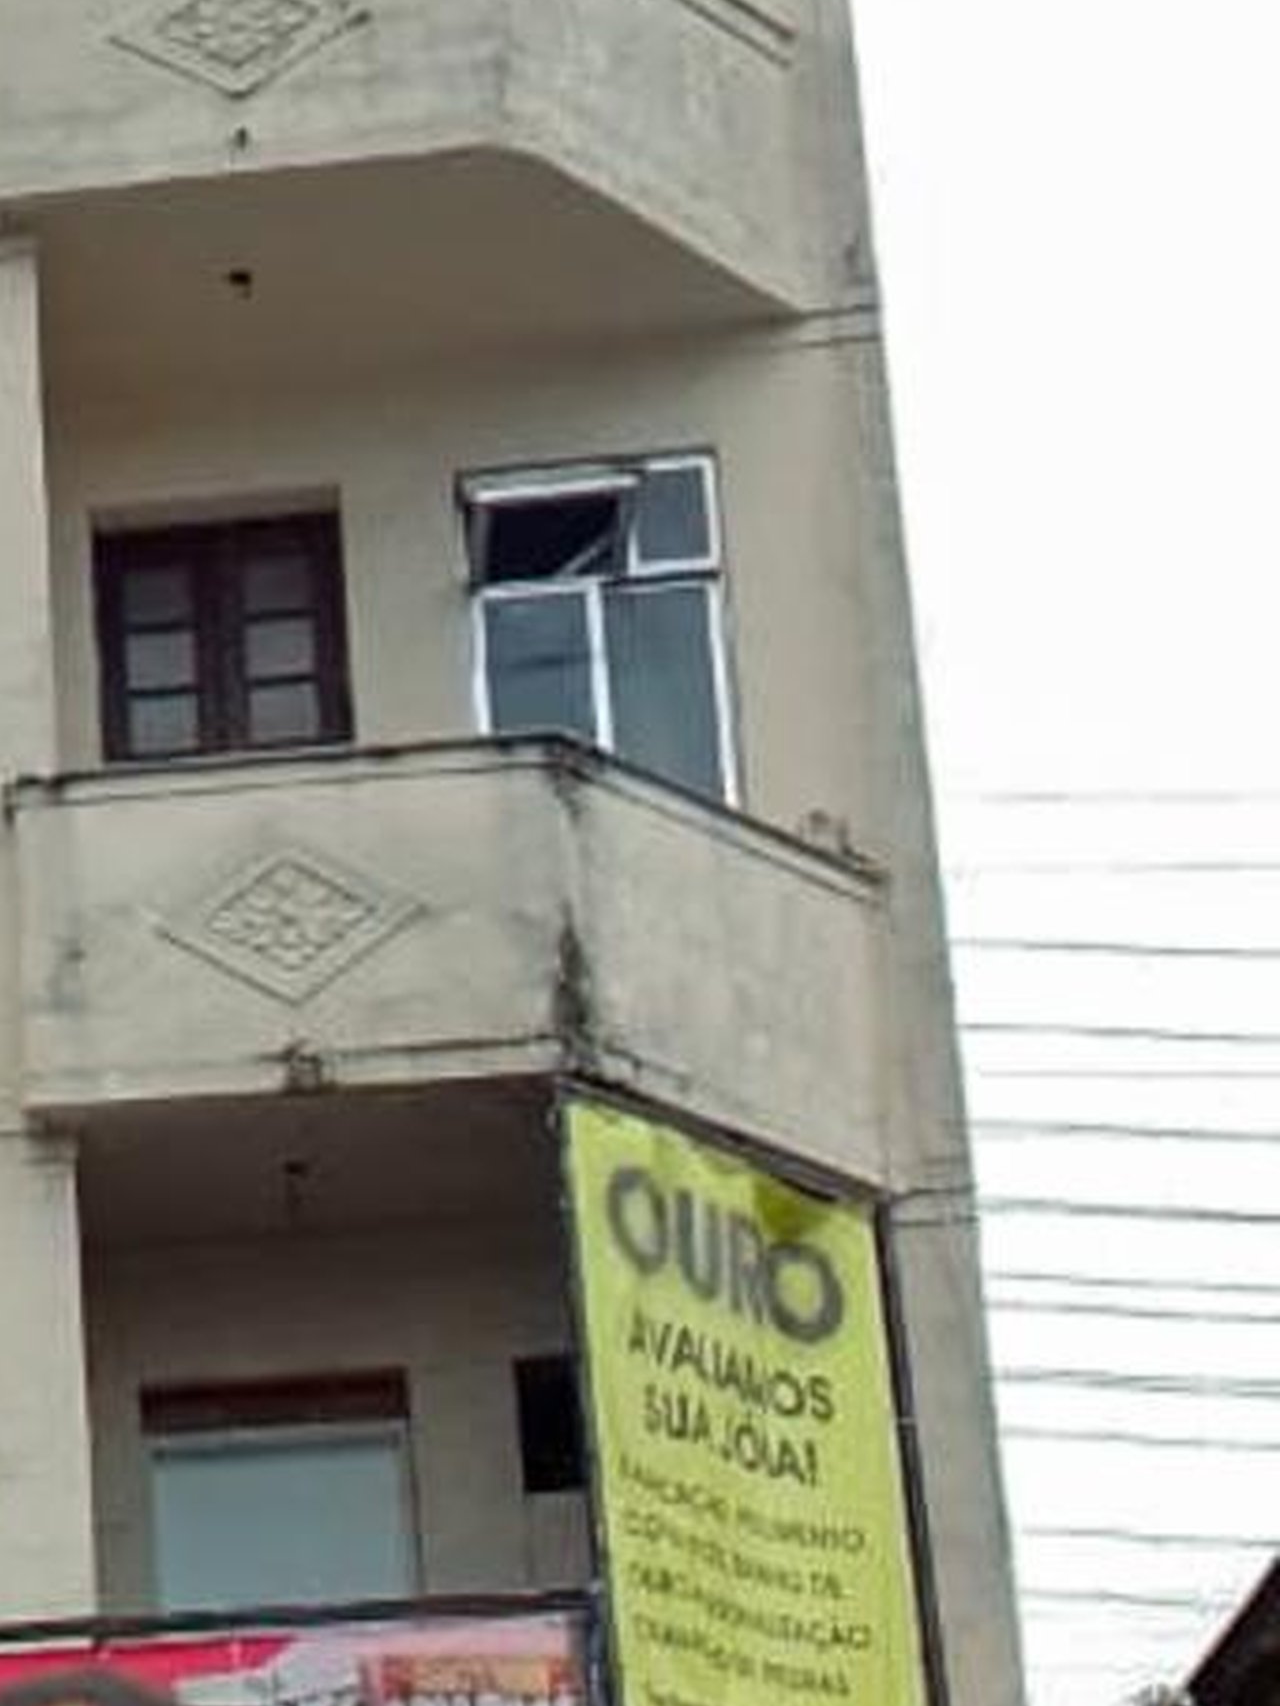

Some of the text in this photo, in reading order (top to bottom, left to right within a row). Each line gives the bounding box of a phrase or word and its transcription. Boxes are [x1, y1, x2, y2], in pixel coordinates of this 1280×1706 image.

[607, 1166, 844, 1345] OURO
[629, 1305, 836, 1424] AVALIAMOS
[642, 1382, 714, 1444] SUA
